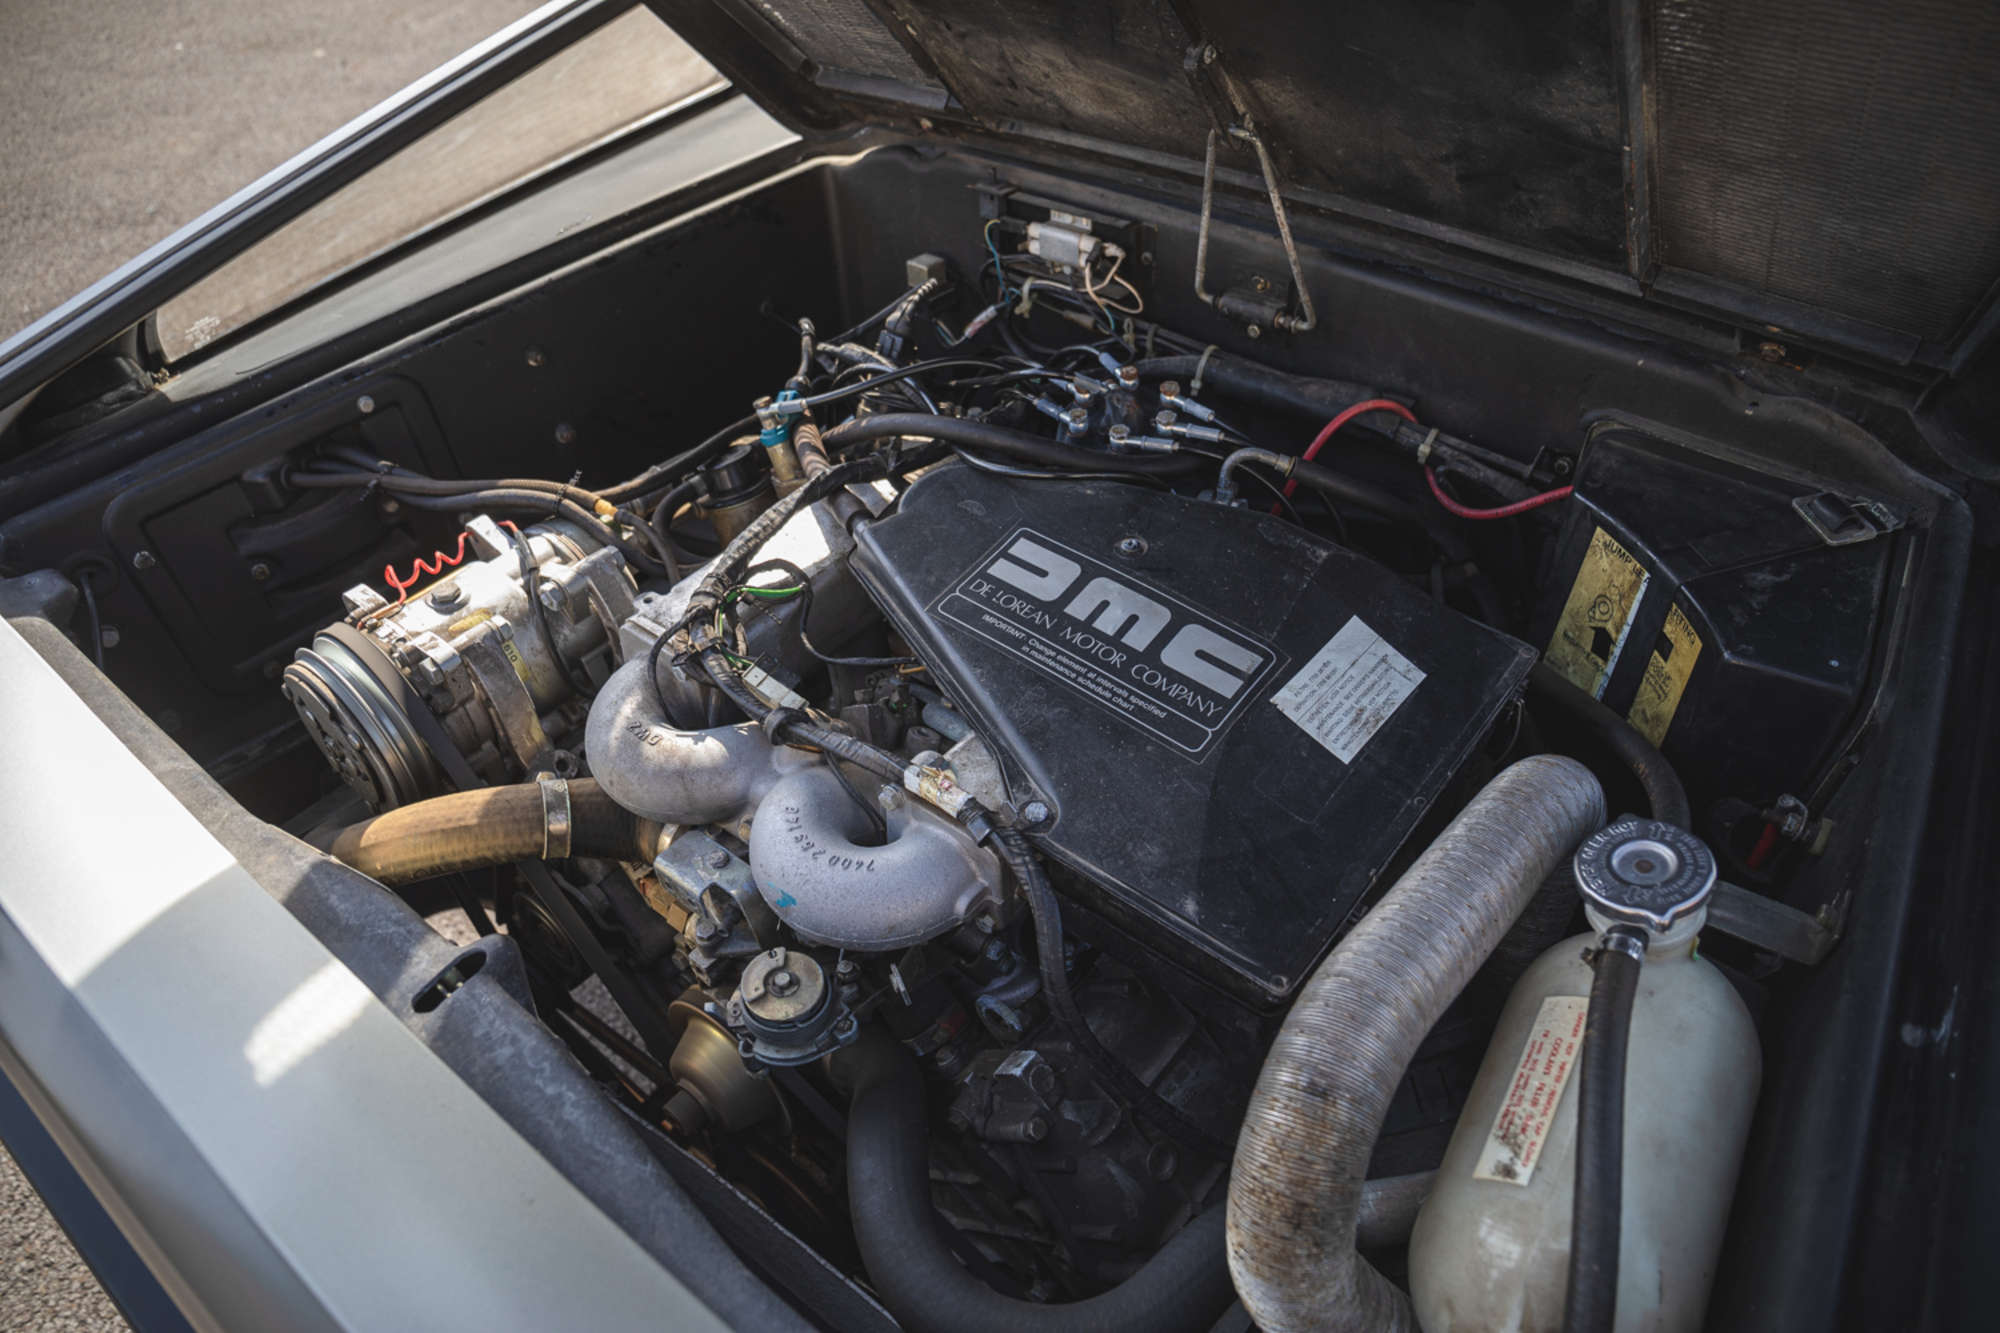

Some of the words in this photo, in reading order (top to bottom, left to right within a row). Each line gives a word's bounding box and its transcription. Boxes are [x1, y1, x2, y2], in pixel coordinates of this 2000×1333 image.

[968, 578, 996, 598] DE
[991, 590, 1058, 630] LOREAN
[1059, 626, 1127, 668] MOTOR
[1131, 663, 1223, 718] COMPANY
[986, 537, 1264, 699] DMC
[1028, 637, 1057, 659] Change
[1056, 654, 1088, 676] element
[1095, 676, 1129, 699] intervals
[1129, 694, 1168, 719] specified
[1028, 650, 1078, 680] maintenance
[1076, 676, 1113, 699] schedule
[1111, 694, 1136, 712] chart
